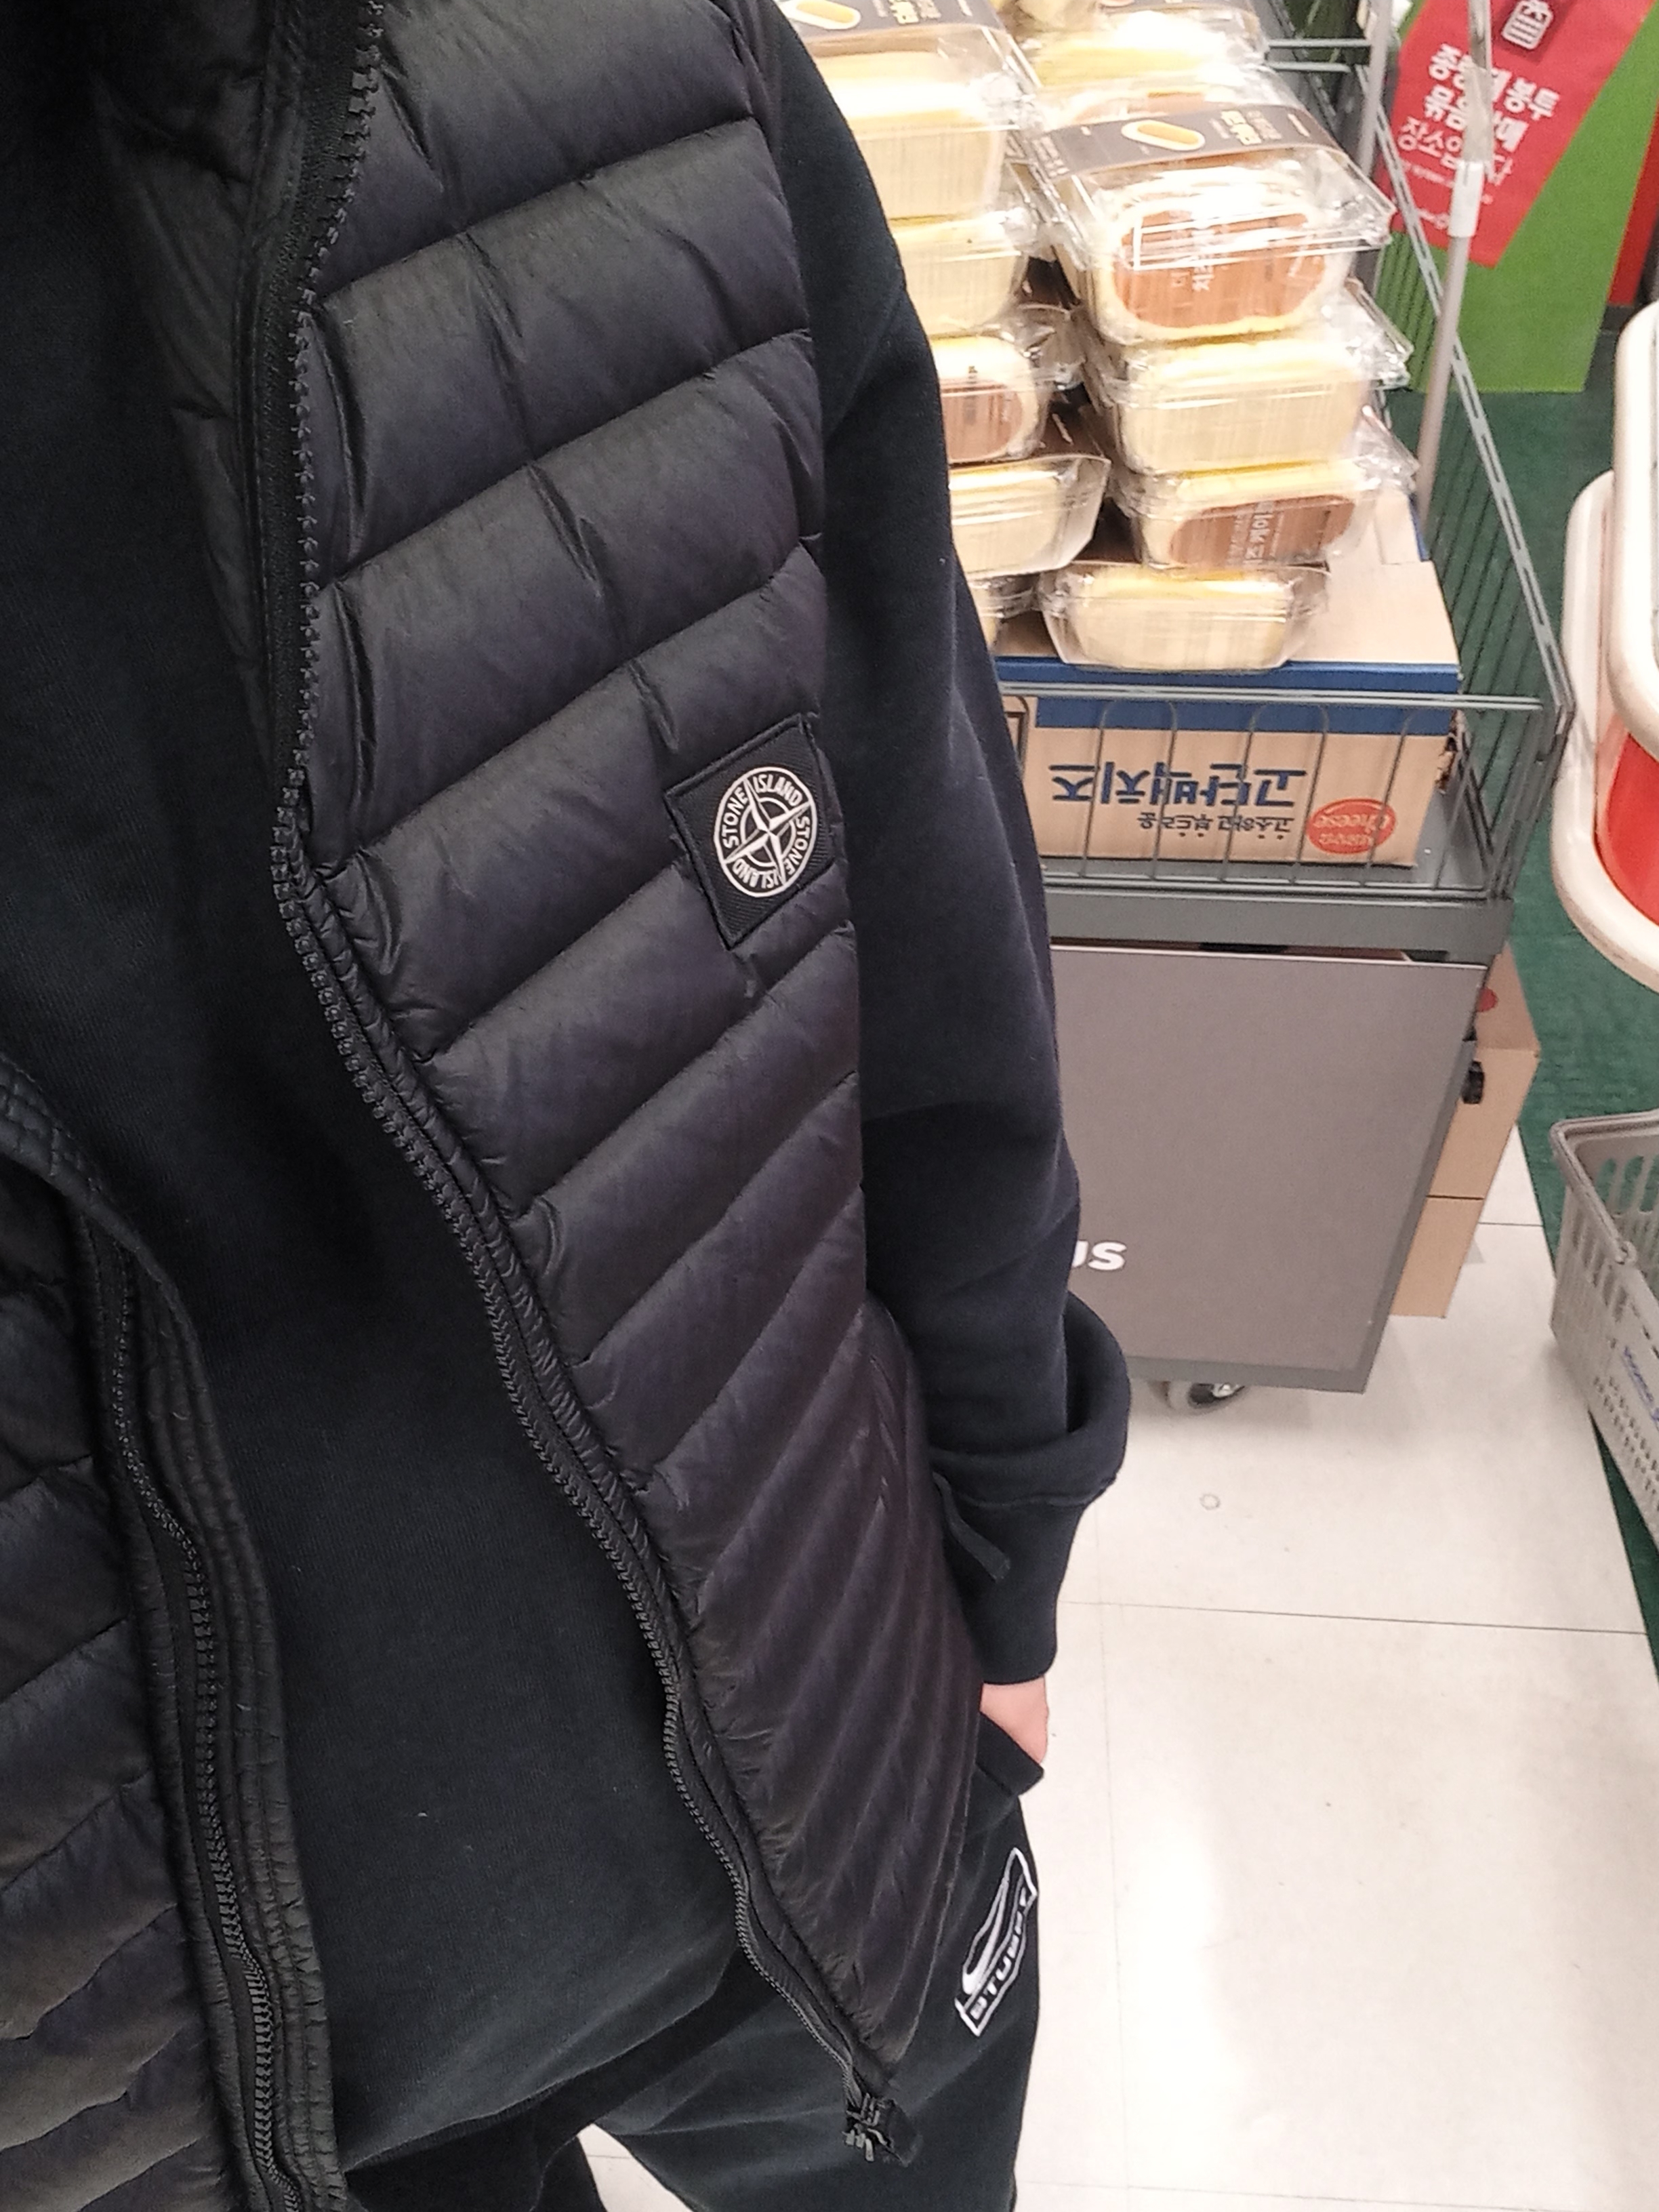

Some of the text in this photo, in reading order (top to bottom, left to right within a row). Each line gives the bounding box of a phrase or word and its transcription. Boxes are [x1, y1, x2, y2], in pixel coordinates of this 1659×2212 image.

[722, 773, 804, 849] STONE ISLAND
[1048, 760, 1308, 808] 고단백치즈
[731, 815, 811, 890] STONE ISLAND
